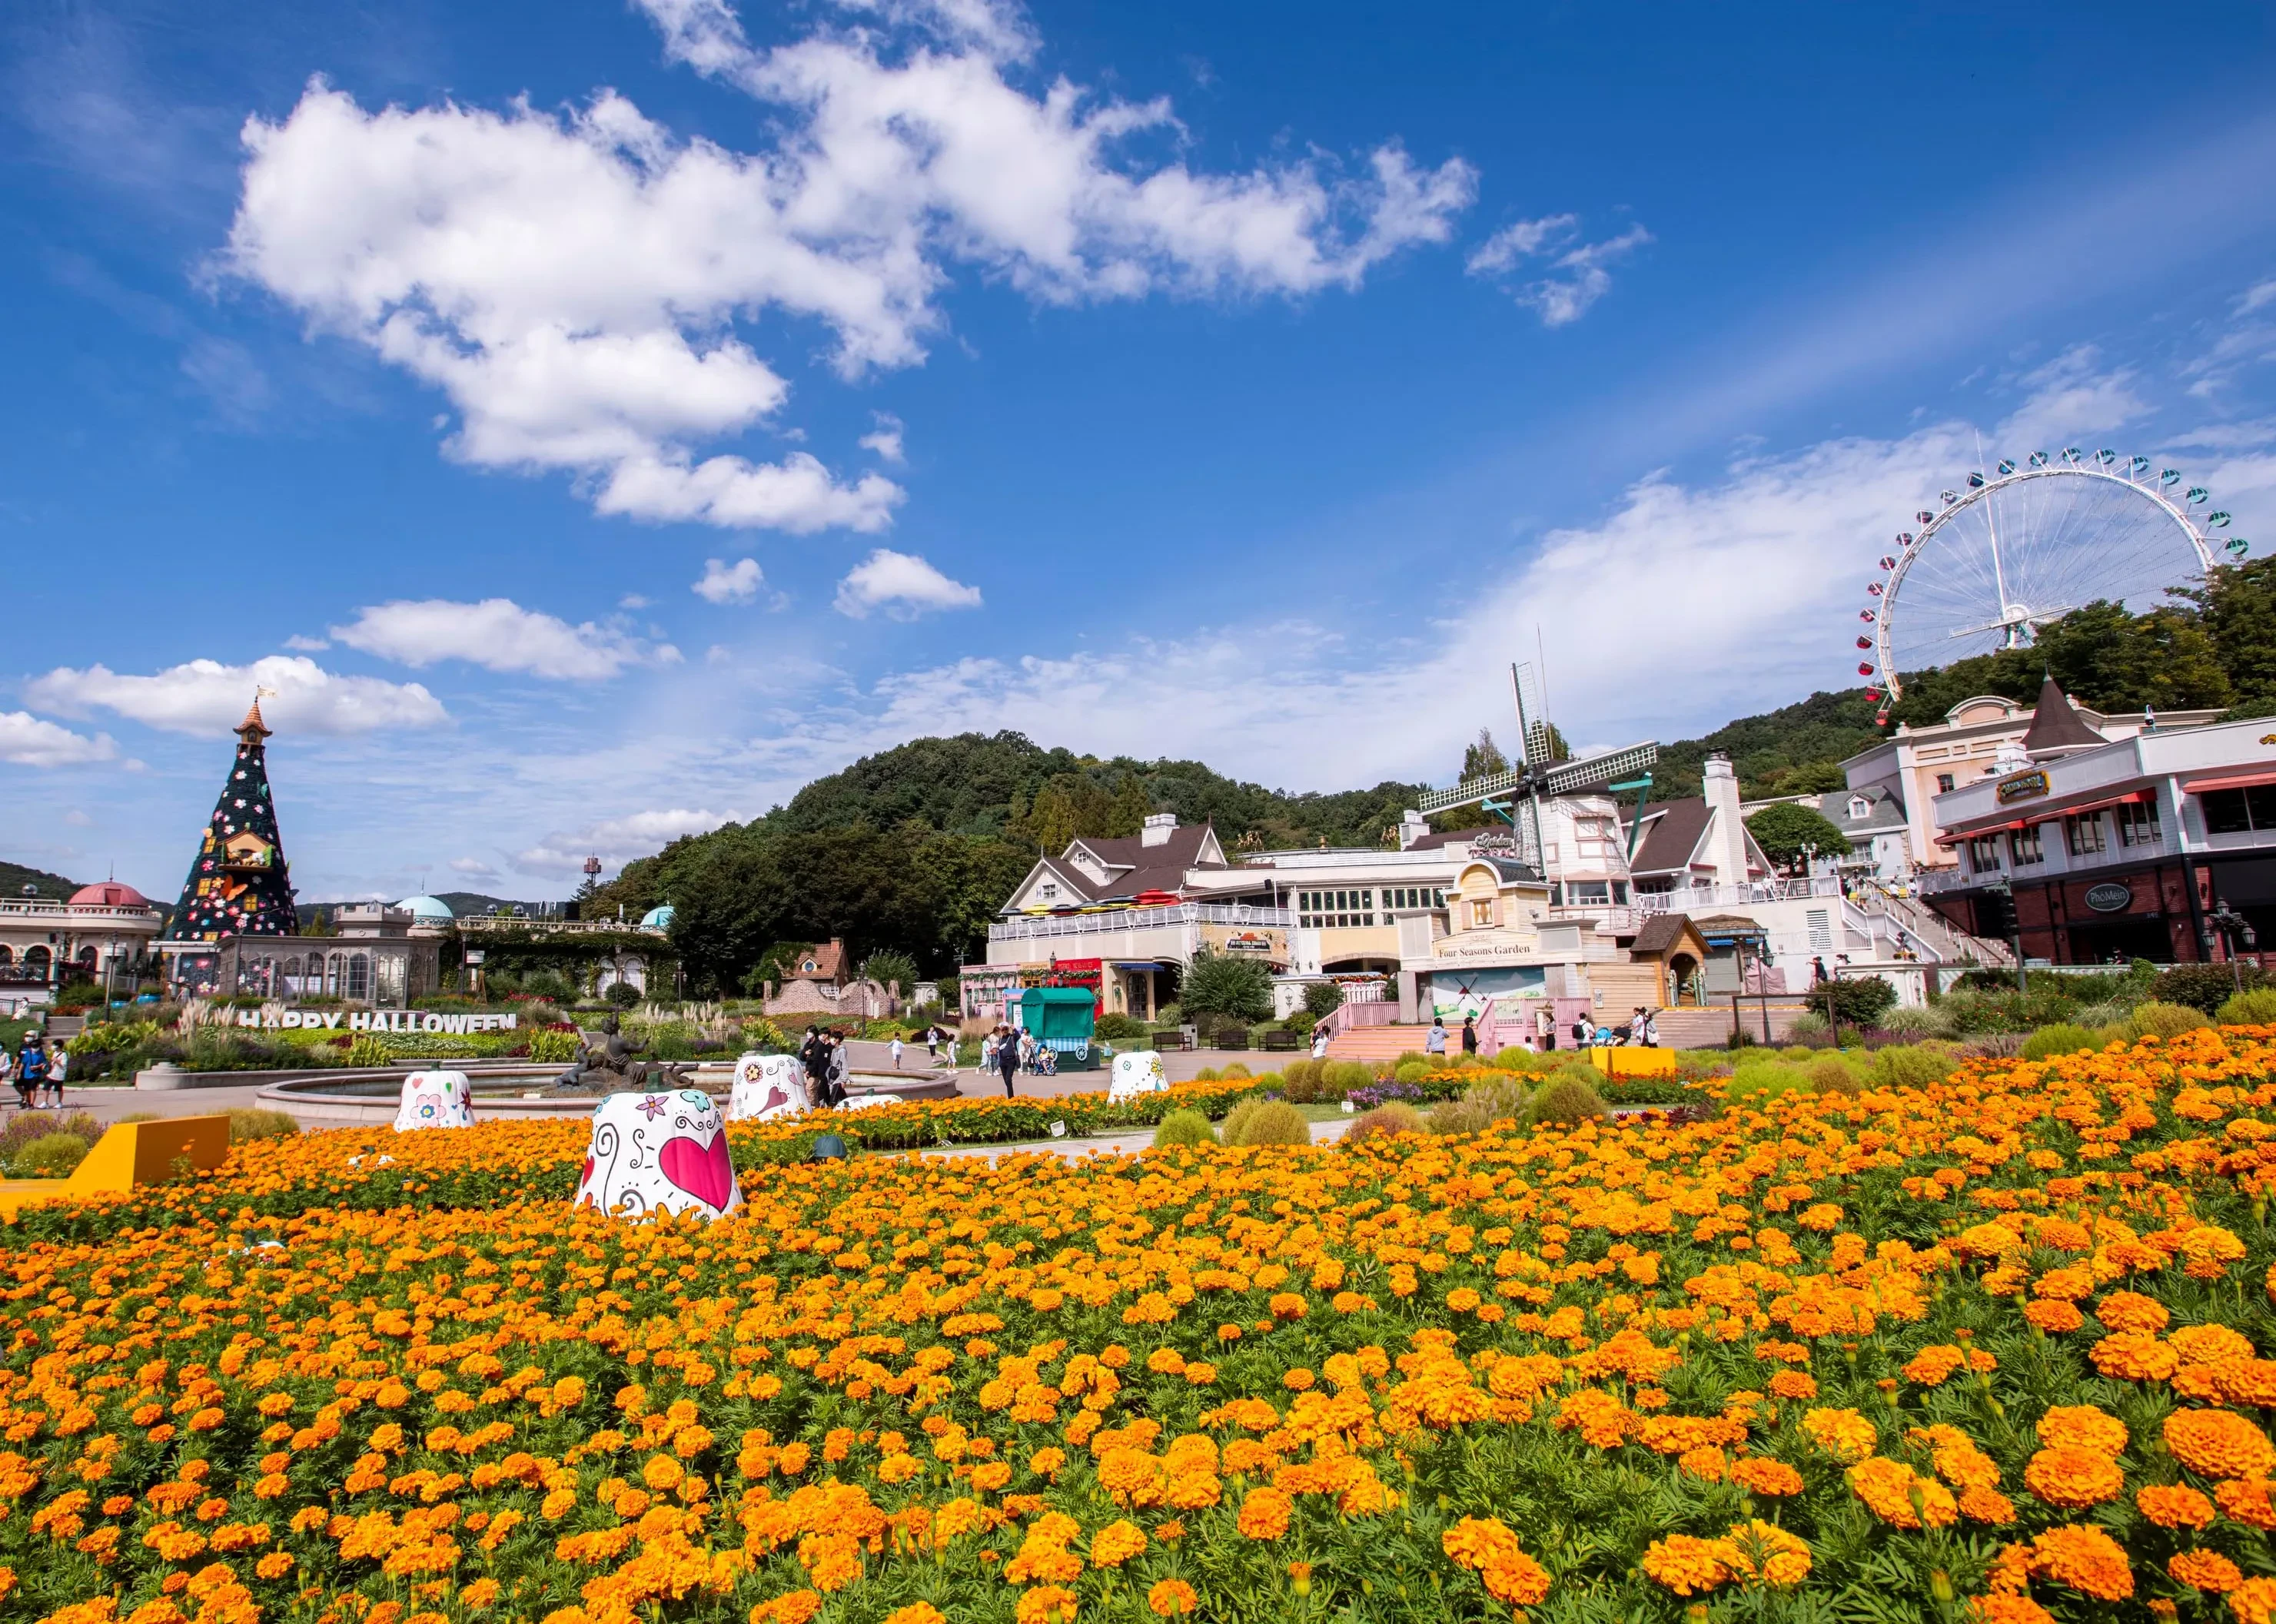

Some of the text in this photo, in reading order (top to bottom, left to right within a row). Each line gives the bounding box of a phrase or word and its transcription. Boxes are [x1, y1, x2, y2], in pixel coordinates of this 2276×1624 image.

[1475, 832, 1515, 851] Garden
[1439, 944, 1530, 958] Four Seasons Garden
[239, 1011, 517, 1035] HAPPY HALLOWEEN
